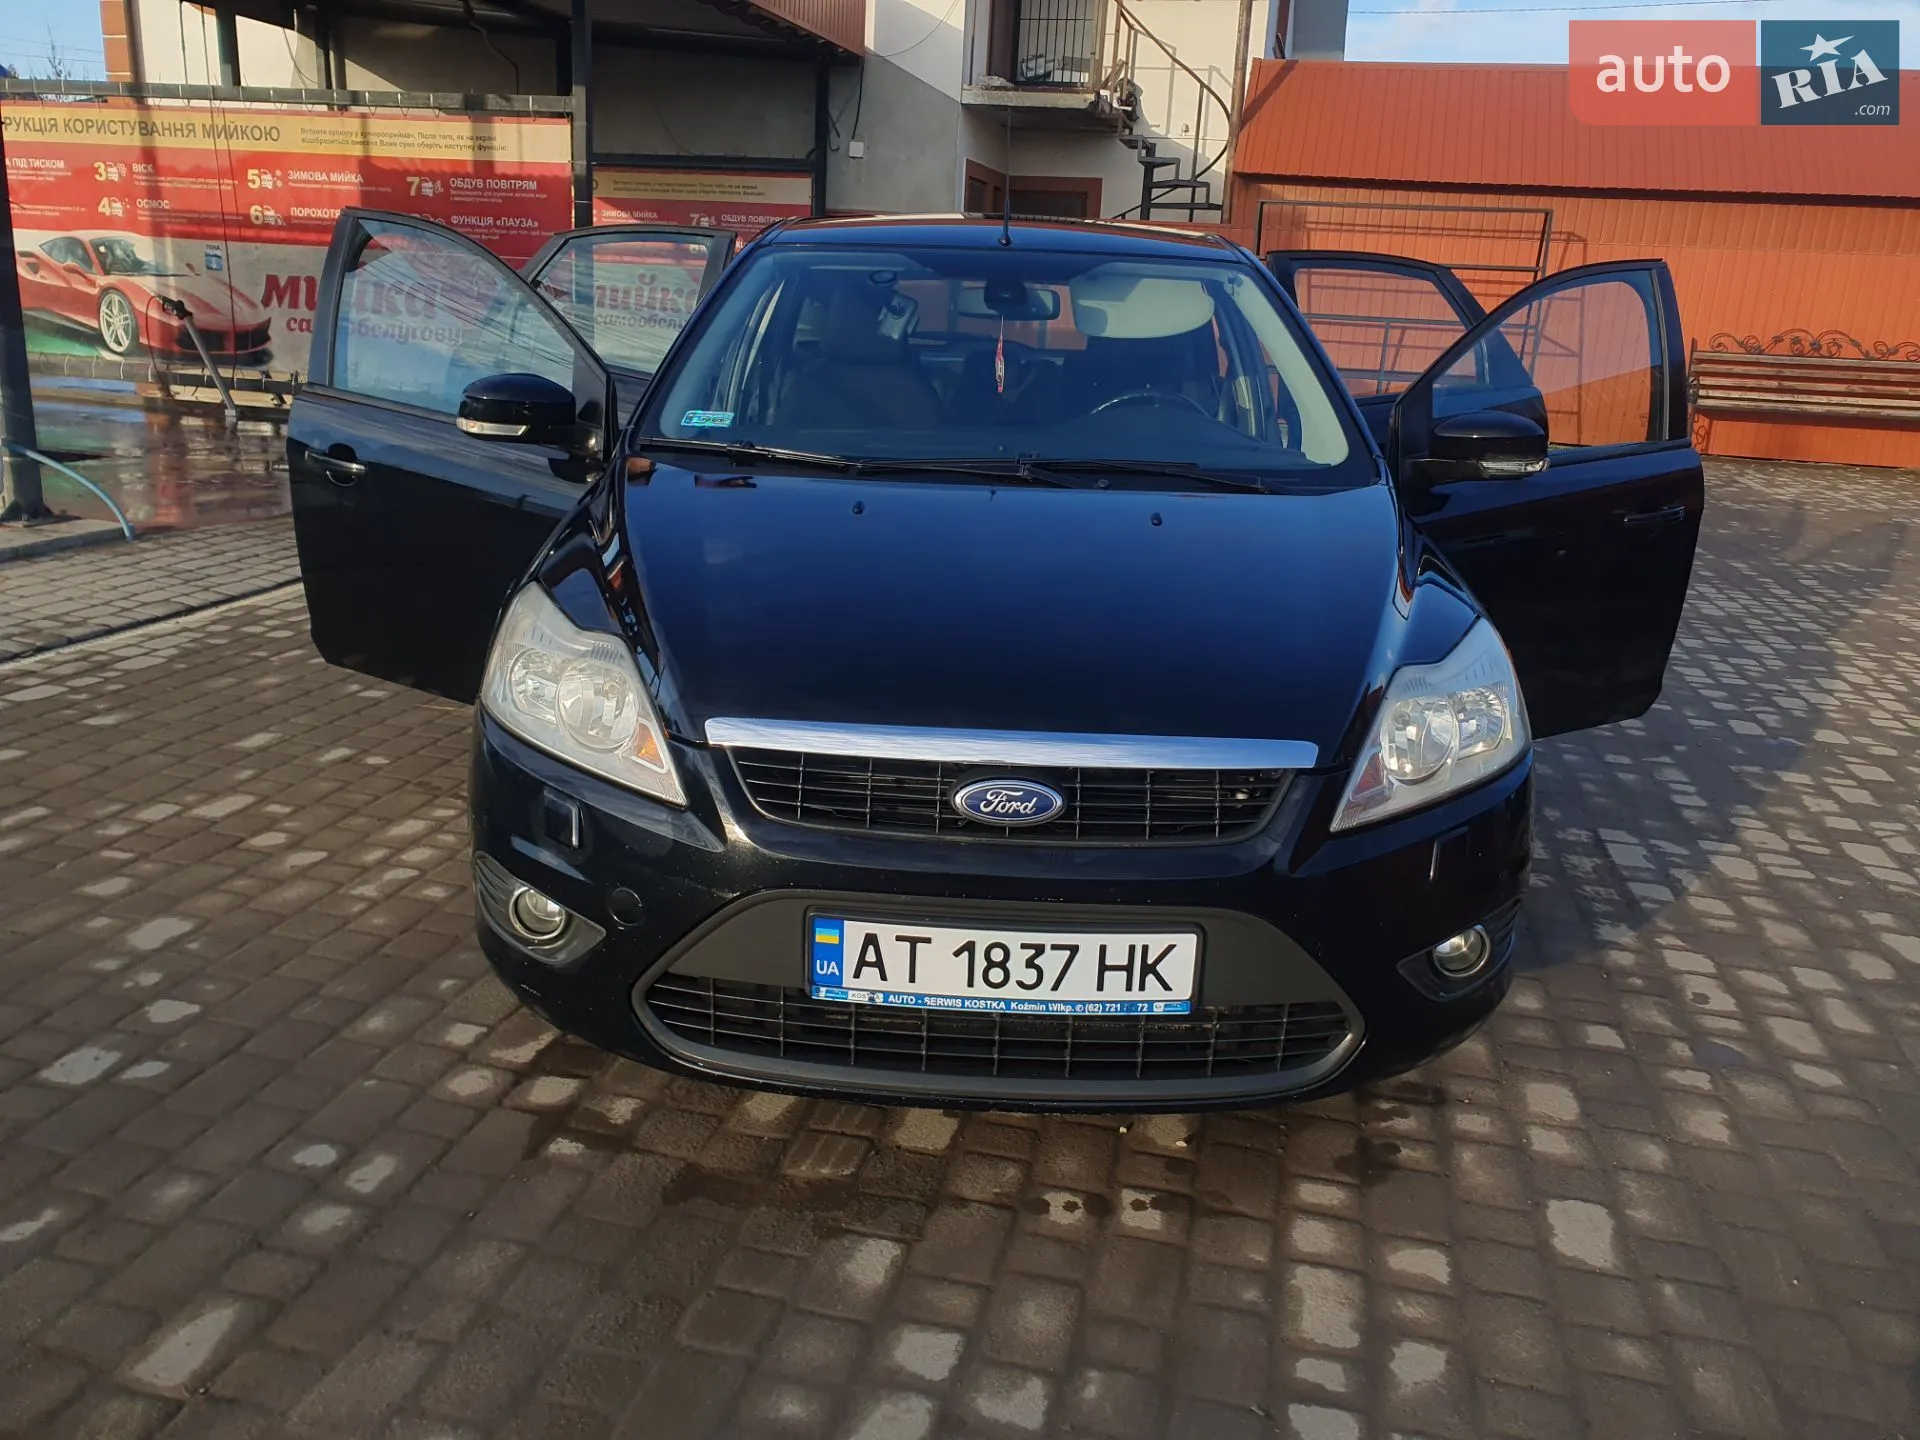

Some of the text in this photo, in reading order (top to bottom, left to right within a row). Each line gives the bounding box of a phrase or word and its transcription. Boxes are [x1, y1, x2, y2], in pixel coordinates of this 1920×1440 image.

[3, 116, 281, 142] РУКЦІЯ КОРИСТУВАННЯ МИЙКОЮ
[28, 158, 65, 169] ТИСКОМ
[93, 161, 107, 181] 3
[247, 169, 261, 189] 5
[288, 170, 364, 183] ЗИМОВА МИЙКА
[450, 177, 537, 191] ОБДУВ ПОВІТРЯМ
[406, 176, 420, 197] 7
[97, 197, 111, 216] 4
[136, 199, 170, 209] ОСМОС
[291, 207, 343, 218] ПОРОХОТЯ
[250, 205, 264, 224] 6
[451, 215, 494, 227] ФУНКЦІЯ
[689, 213, 700, 227] 7
[721, 214, 747, 223] ОБДУВ
[980, 789, 1037, 814] Ford
[816, 958, 840, 977] UA
[853, 932, 1178, 993] AT 1837 HK
[888, 993, 916, 1005] AUTO
[924, 996, 962, 1007] SERWIS
[965, 999, 1005, 1010] KOSTKA
[1085, 1003, 1102, 1014] (62)
[1105, 1003, 1121, 1013] 721
[1137, 1003, 1148, 1012] 72
